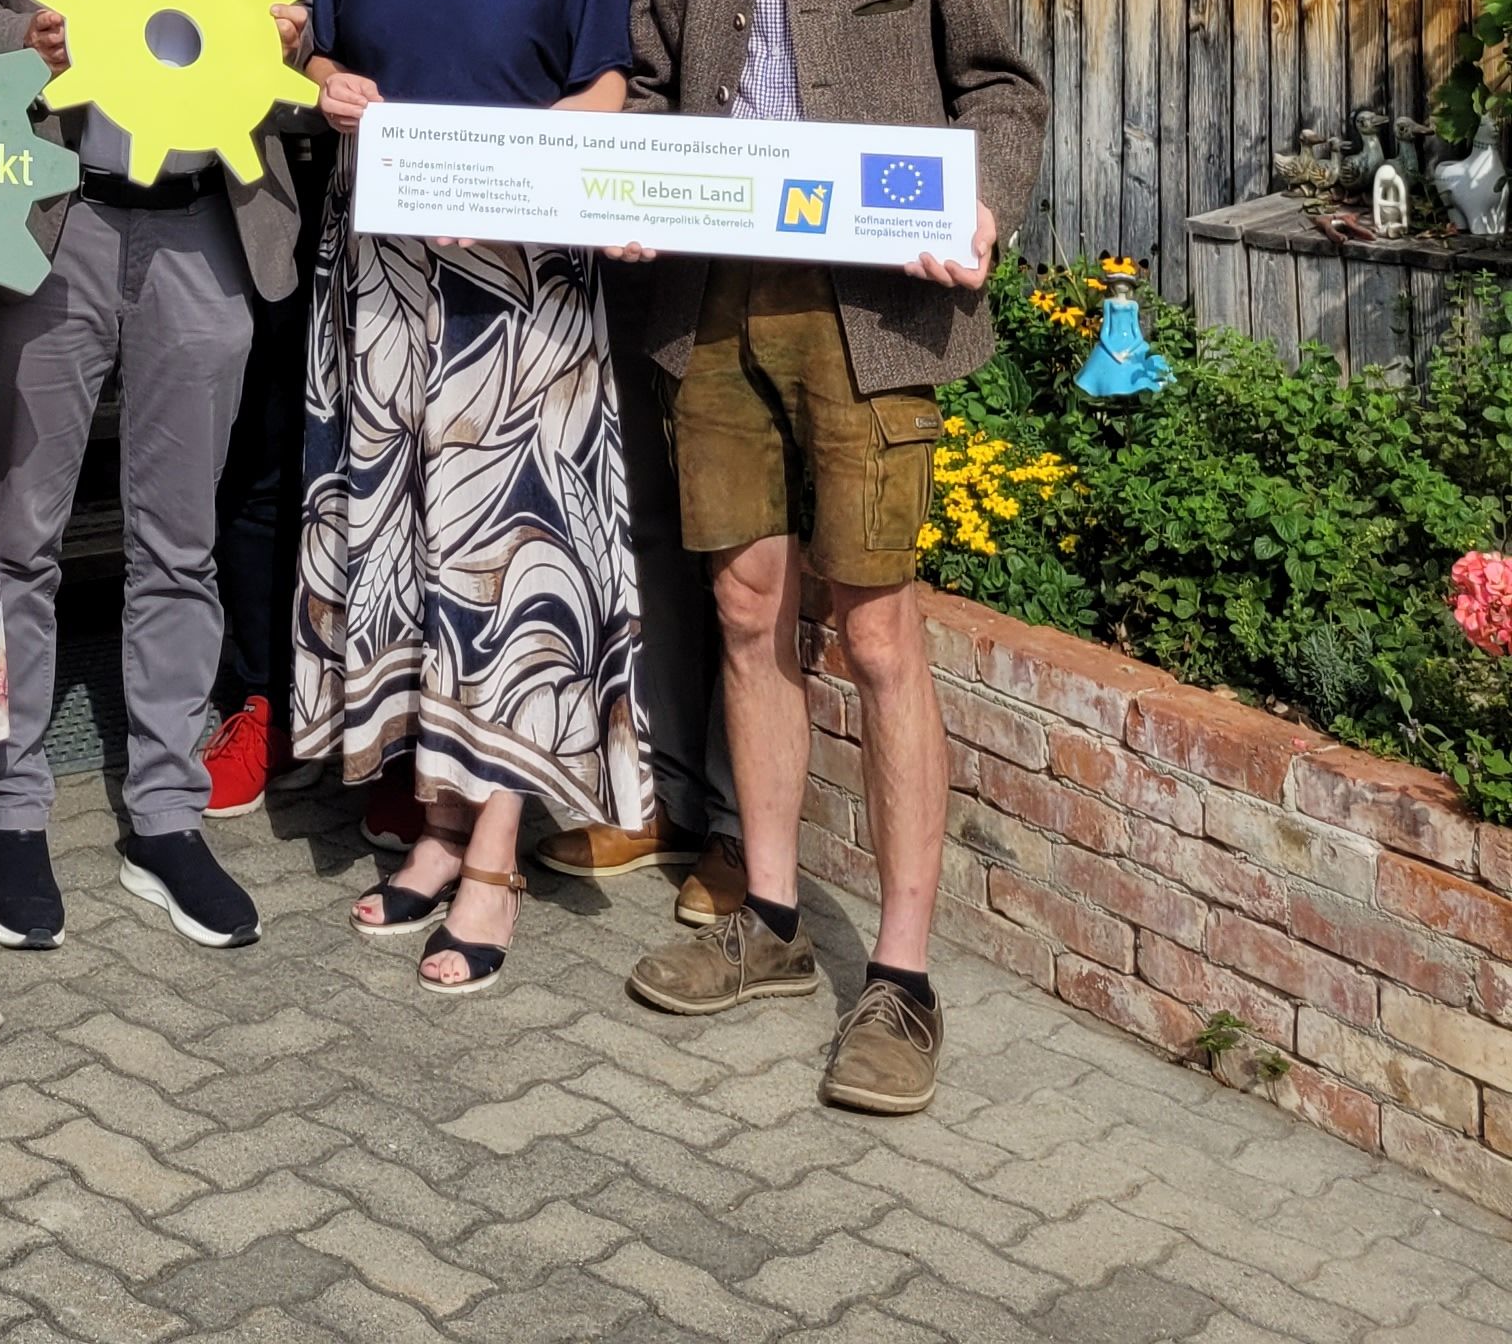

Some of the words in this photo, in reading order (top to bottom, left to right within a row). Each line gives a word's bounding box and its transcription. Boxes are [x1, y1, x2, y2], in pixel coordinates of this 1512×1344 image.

[381, 126, 405, 140] Mit
[408, 128, 506, 146] Unterstützung
[509, 135, 534, 146] von
[538, 133, 578, 149] Bund,
[583, 136, 615, 149] Land
[620, 138, 646, 151] und
[651, 139, 743, 156] Europäischer
[748, 144, 791, 159] Union
[399, 158, 495, 173] Bundesministerium
[398, 173, 427, 184] Land-
[430, 174, 448, 184] und
[452, 175, 534, 190] Forstwirtschaft,
[581, 177, 636, 202] WIR
[642, 180, 693, 200] leben
[700, 184, 745, 203] Land
[398, 186, 430, 197] Klima-
[433, 188, 452, 198] und
[455, 189, 531, 203] Umweltschutz,
[397, 199, 443, 211] Regionen
[447, 201, 465, 212] und
[469, 202, 558, 217] Wasserwirtschaft
[579, 209, 640, 222] Gemeinsame
[643, 213, 700, 226] Agrarpolitik
[703, 214, 754, 229] Österreich
[854, 215, 913, 227] Kofinanziert
[916, 219, 934, 228] von
[935, 218, 953, 229] der
[854, 227, 920, 239] Europäischen
[922, 231, 953, 241] Union
